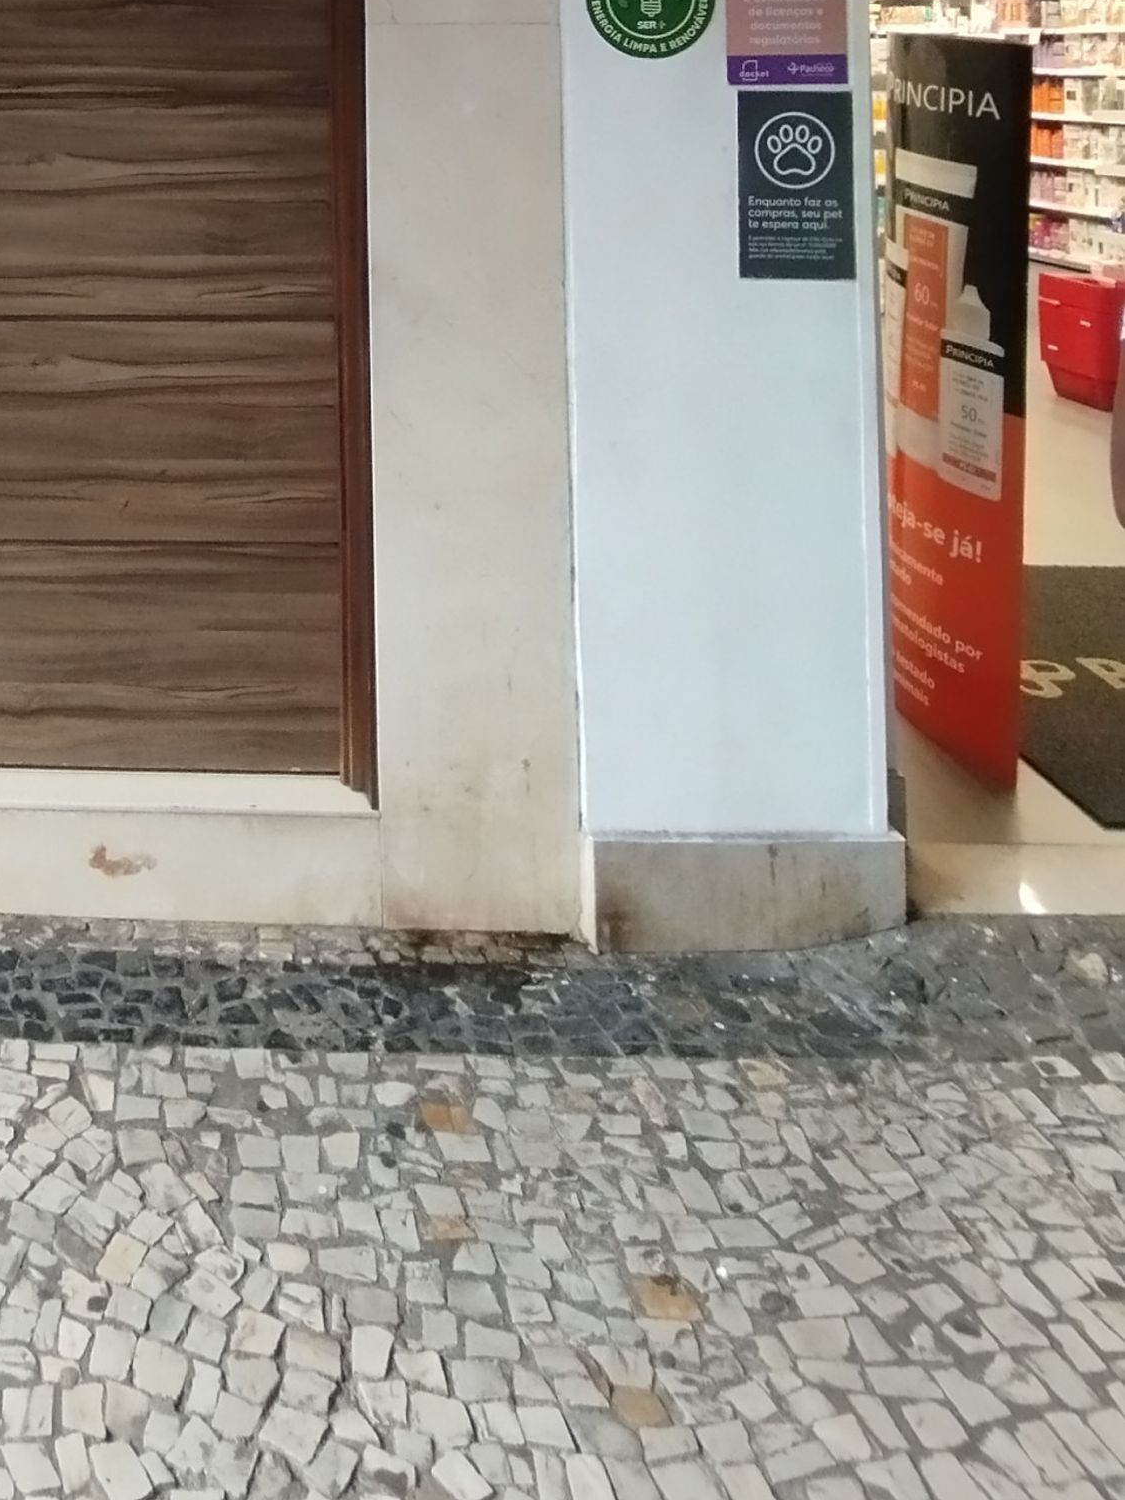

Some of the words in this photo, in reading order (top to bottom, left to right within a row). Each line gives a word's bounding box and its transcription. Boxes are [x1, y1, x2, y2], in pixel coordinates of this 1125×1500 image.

[591, 0, 622, 42] ENERGIA
[623, 38, 657, 53] LIMPA
[660, 42, 668, 52] E
[637, 20, 656, 30] SER
[748, 195, 802, 207] Enquanto
[804, 196, 822, 207] faz
[824, 199, 839, 208] as
[904, 187, 950, 212] PRINCIPIA
[748, 209, 799, 219] compras,
[801, 211, 821, 219] seu
[823, 210, 843, 222] pet
[748, 220, 760, 229] te
[761, 221, 800, 231] espera
[914, 282, 930, 306] 60
[945, 344, 995, 368] PRINCIPIA
[960, 404, 978, 423] 50
[948, 529, 982, 564] já!
[955, 641, 983, 661] por
